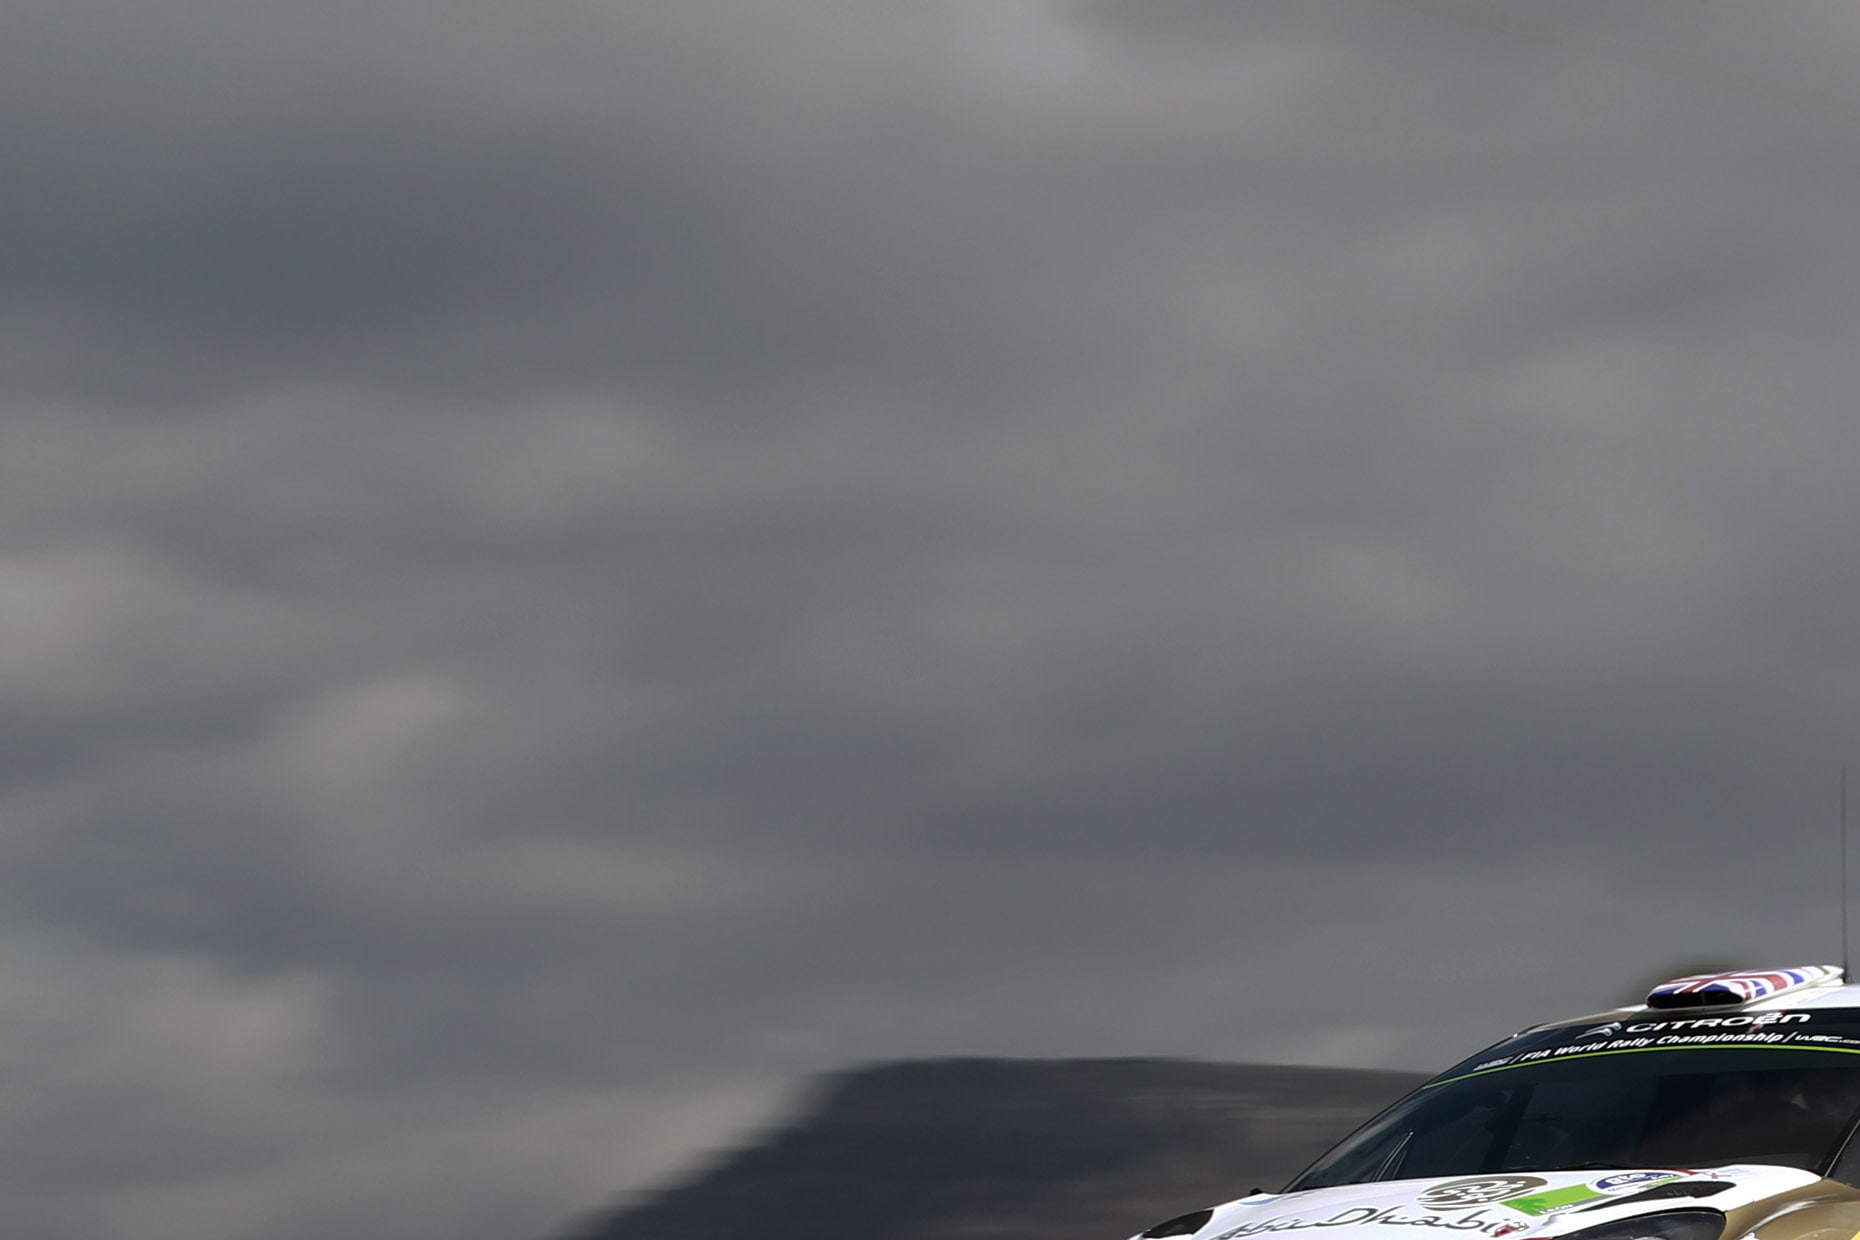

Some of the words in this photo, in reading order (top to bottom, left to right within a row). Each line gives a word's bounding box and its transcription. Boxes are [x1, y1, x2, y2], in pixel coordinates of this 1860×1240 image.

[1520, 1049, 1552, 1061] FIA
[1554, 1042, 1605, 1056] World
[1606, 1037, 1653, 1049] Rally
[1656, 1032, 1784, 1045] Championship
